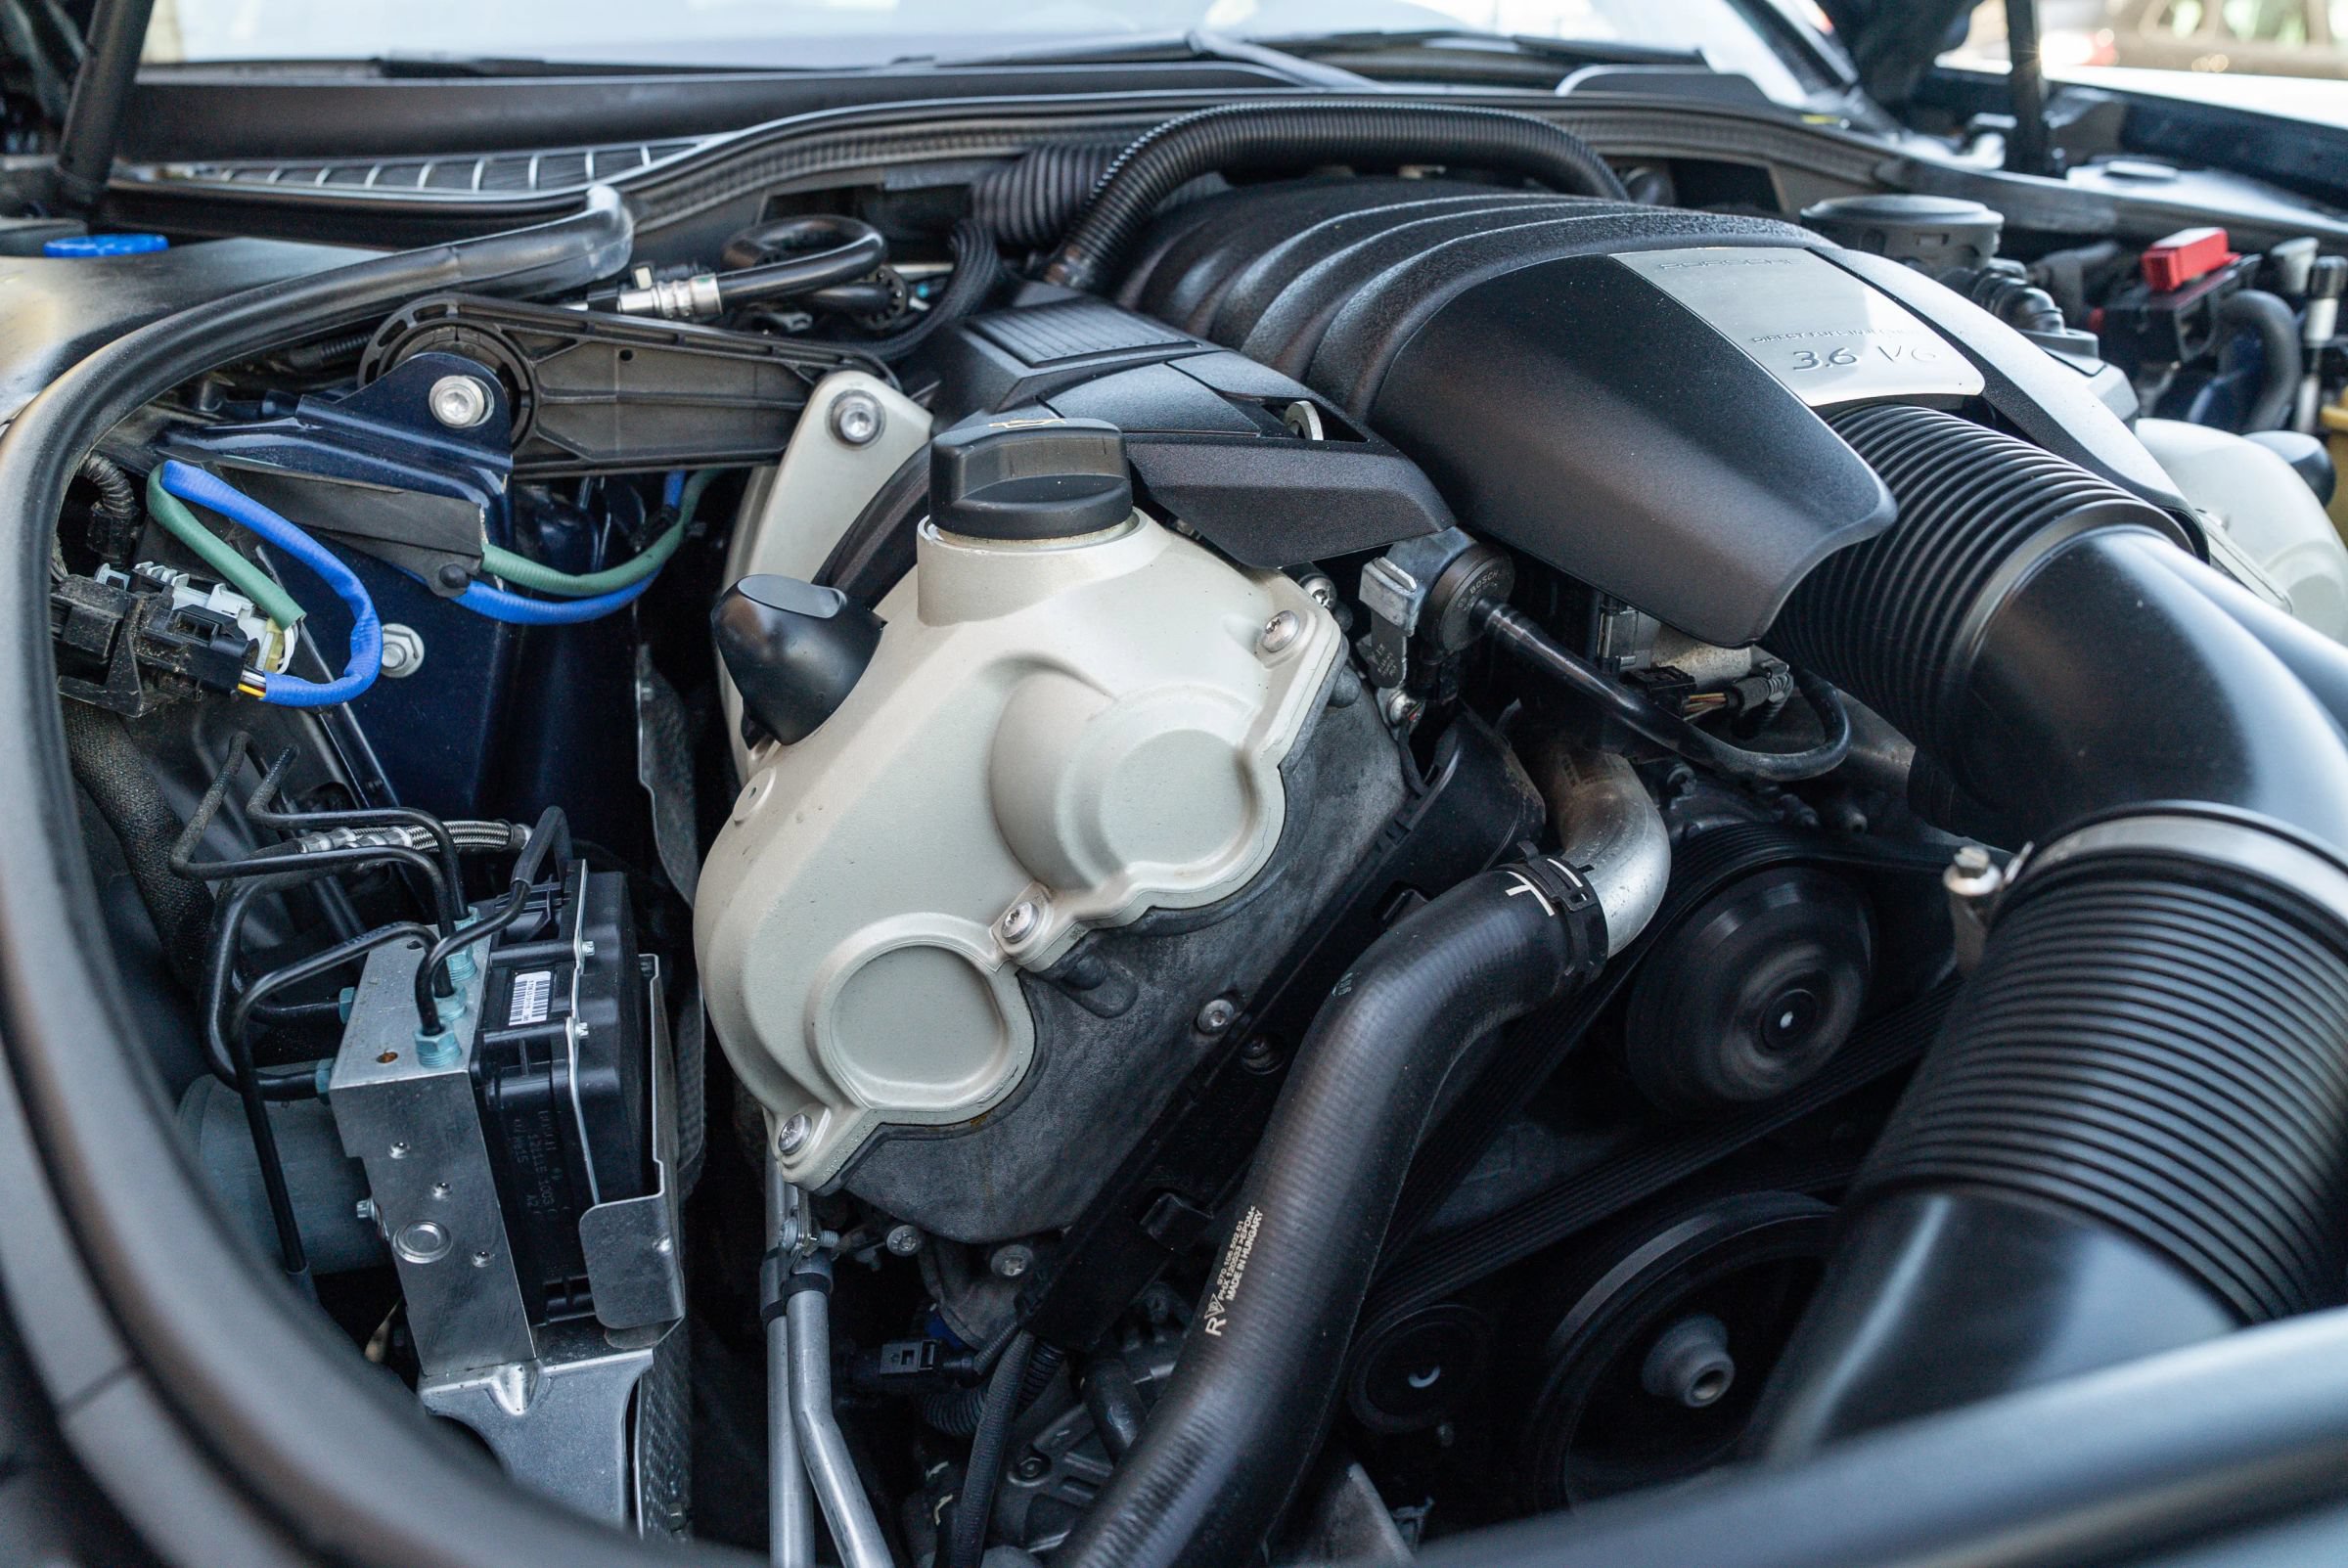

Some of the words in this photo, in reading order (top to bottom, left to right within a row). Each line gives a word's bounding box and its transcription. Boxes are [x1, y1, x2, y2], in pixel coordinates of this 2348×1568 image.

[1751, 331, 1806, 343] DIRECT
[1792, 346, 1858, 371] 3.6
[1469, 570, 1499, 594] BOSCH
[1226, 1271, 1242, 1301] MADE
[1237, 1259, 1247, 1271] IN
[1242, 1209, 1263, 1259] HUNGARY
[1217, 1278, 1231, 1301] PHX
